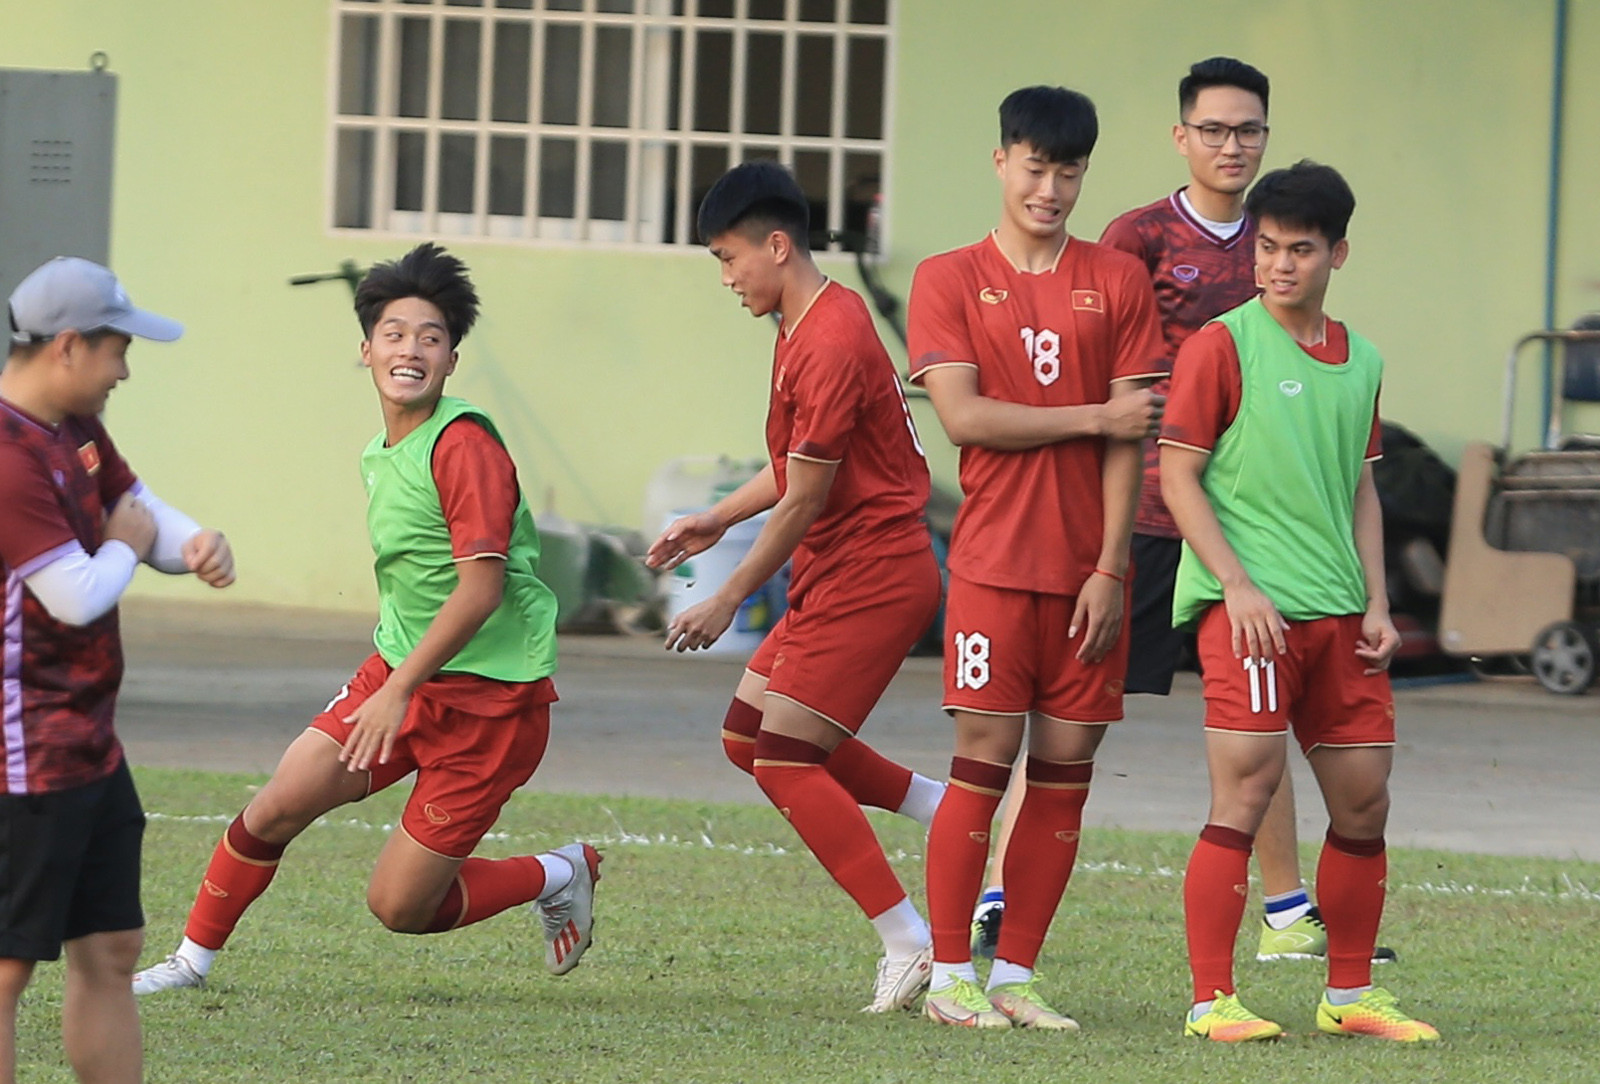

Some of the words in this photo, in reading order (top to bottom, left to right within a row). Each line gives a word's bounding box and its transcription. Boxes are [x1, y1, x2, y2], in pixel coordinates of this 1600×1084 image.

[1020, 326, 1060, 386] 18
[955, 631, 990, 690] 18
[1243, 655, 1277, 713] 11
